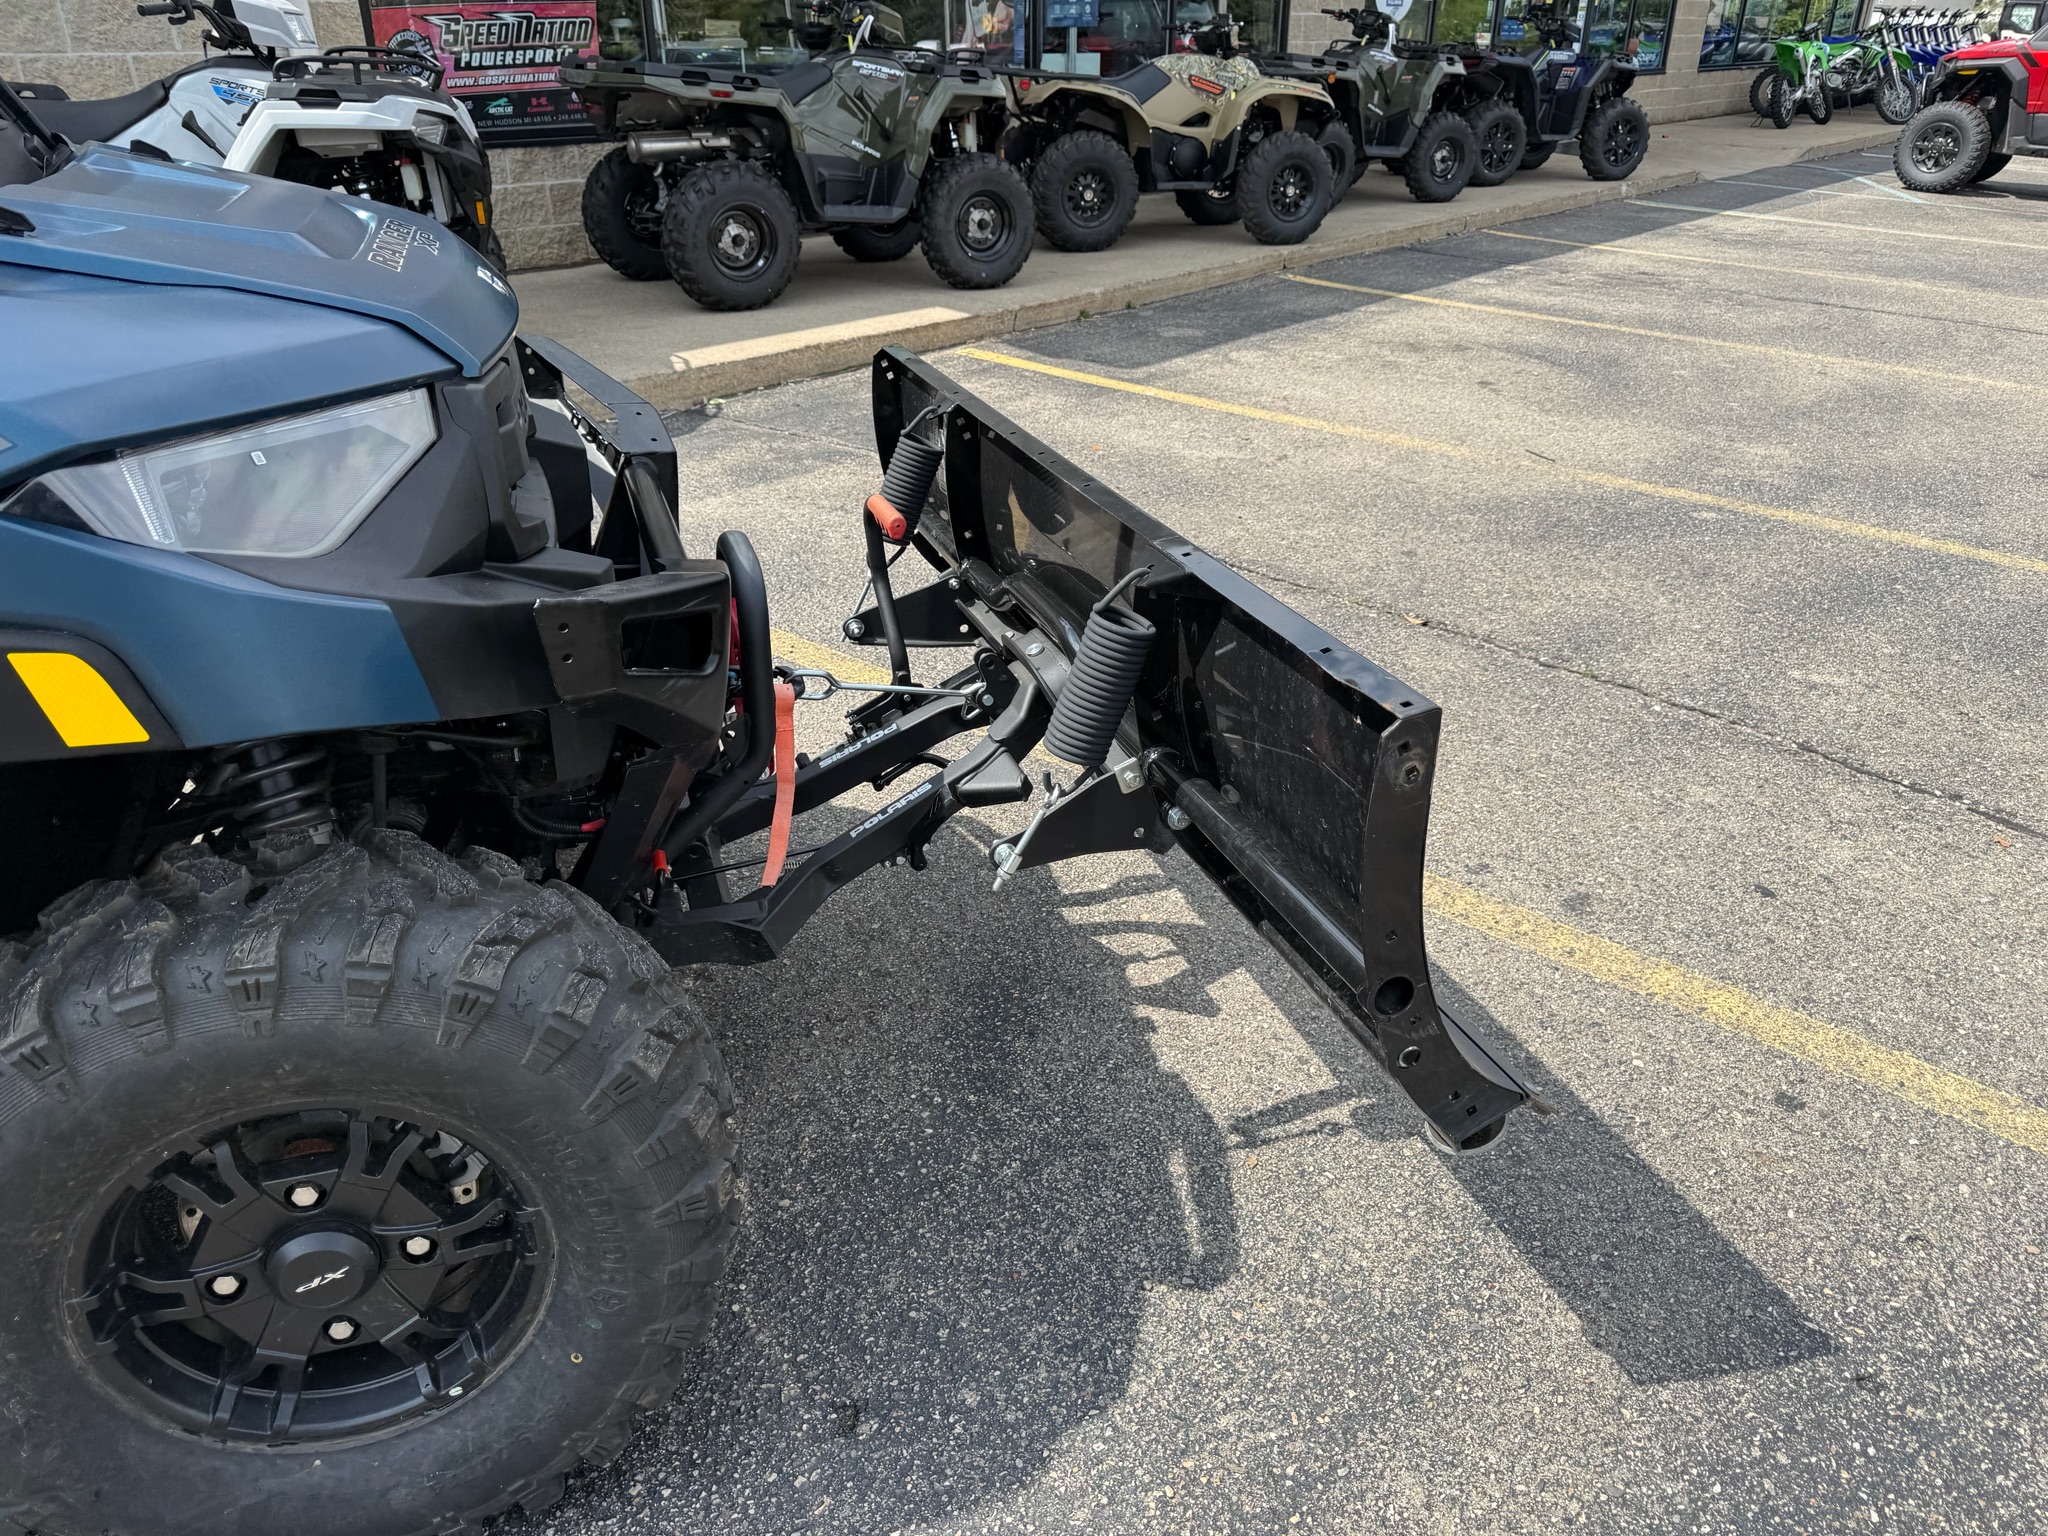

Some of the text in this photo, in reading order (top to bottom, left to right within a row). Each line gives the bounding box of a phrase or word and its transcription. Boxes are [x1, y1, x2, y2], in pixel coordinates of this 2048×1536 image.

[851, 59, 905, 77] SPORTSMAN
[477, 119, 493, 128] NEW
[494, 117, 523, 126] HUDSON
[523, 116, 532, 124] MI
[851, 139, 881, 159] POLARIS
[367, 218, 417, 273] RANGER
[413, 230, 440, 256] XP
[818, 722, 898, 769] POLARIS
[849, 782, 933, 839] POLARIS
[295, 1265, 350, 1293] XP
